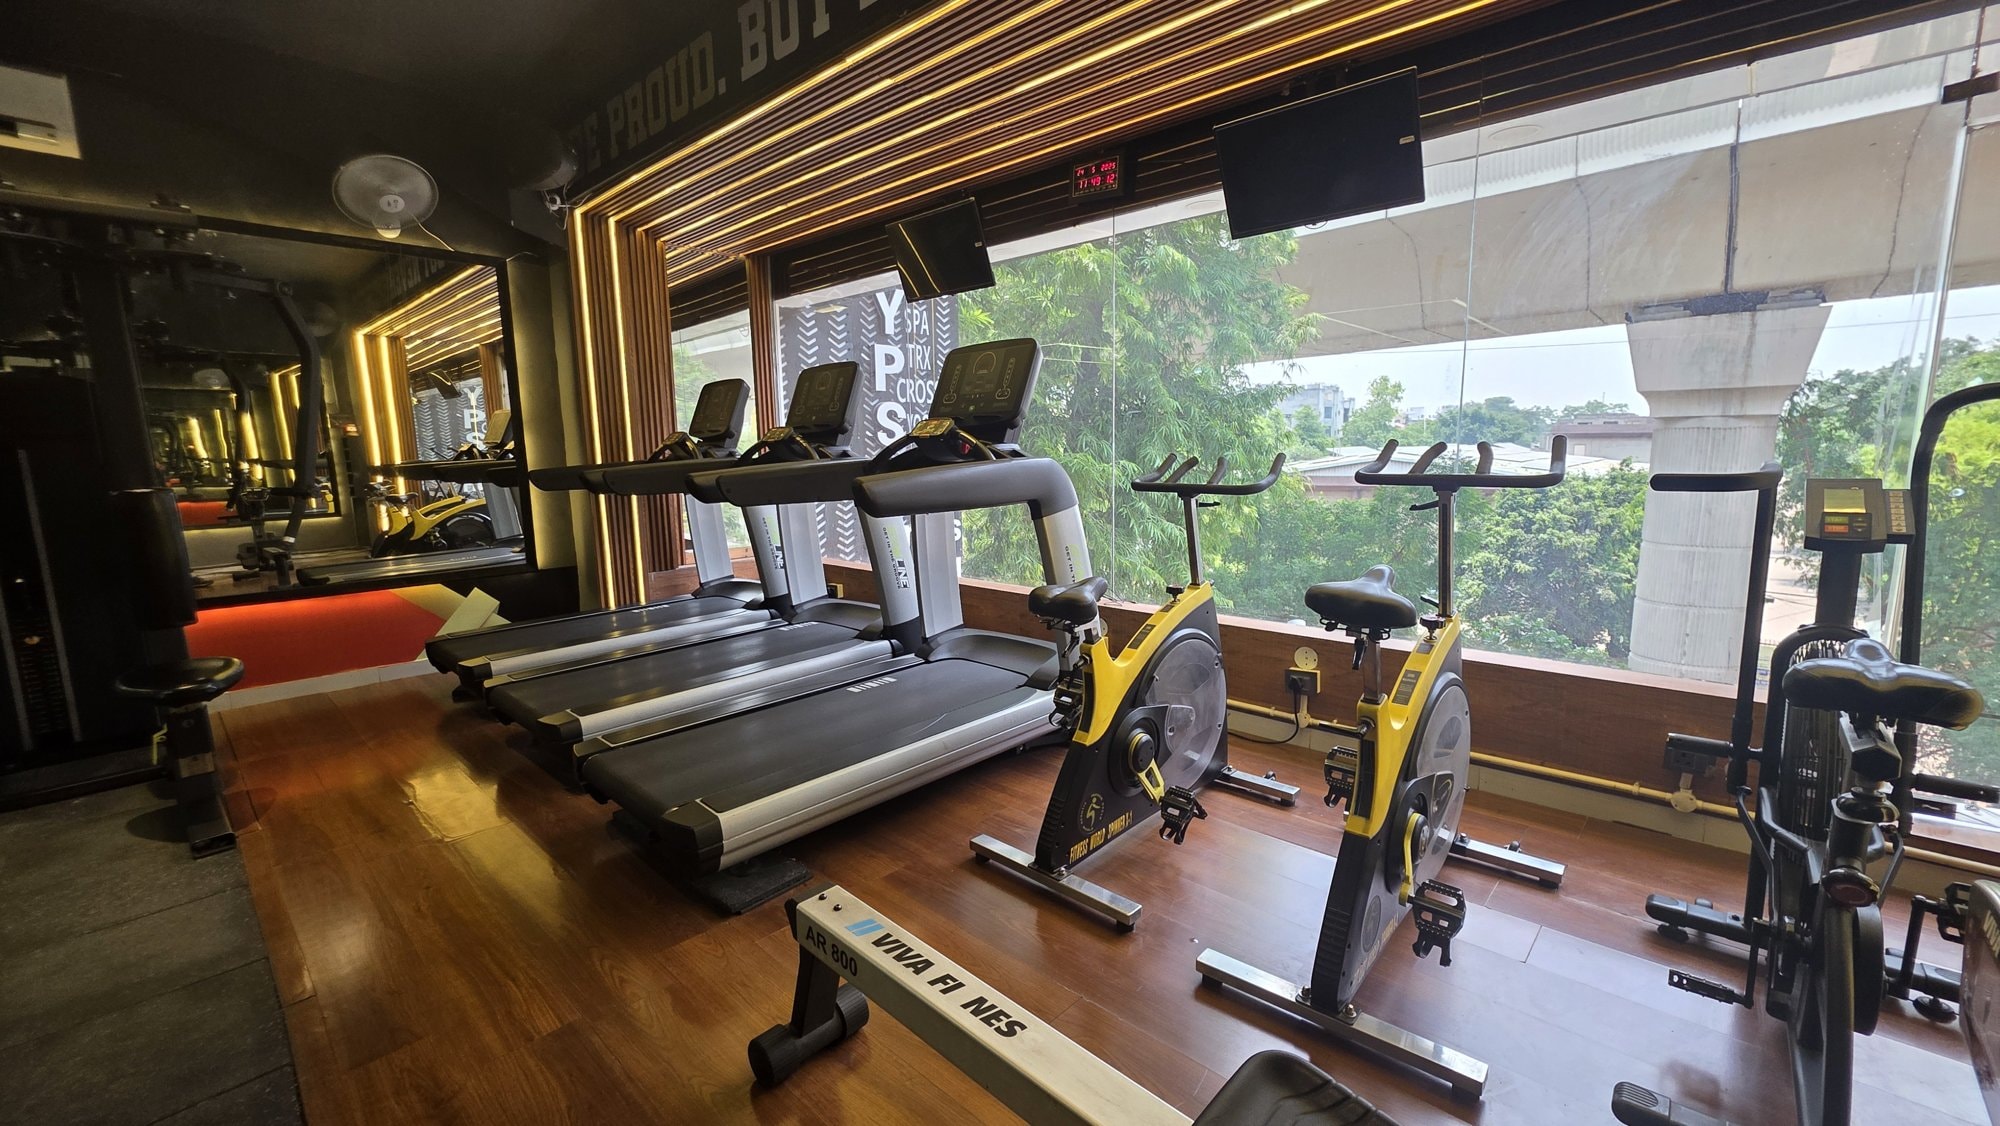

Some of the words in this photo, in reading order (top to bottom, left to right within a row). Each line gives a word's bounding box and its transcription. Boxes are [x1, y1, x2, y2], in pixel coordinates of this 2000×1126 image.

[605, 30, 727, 160] PROUD.
[904, 308, 931, 336] SPA
[906, 343, 932, 371] TRX
[806, 925, 828, 955] AR
[831, 943, 858, 977] 800
[871, 932, 935, 976] VIVA
